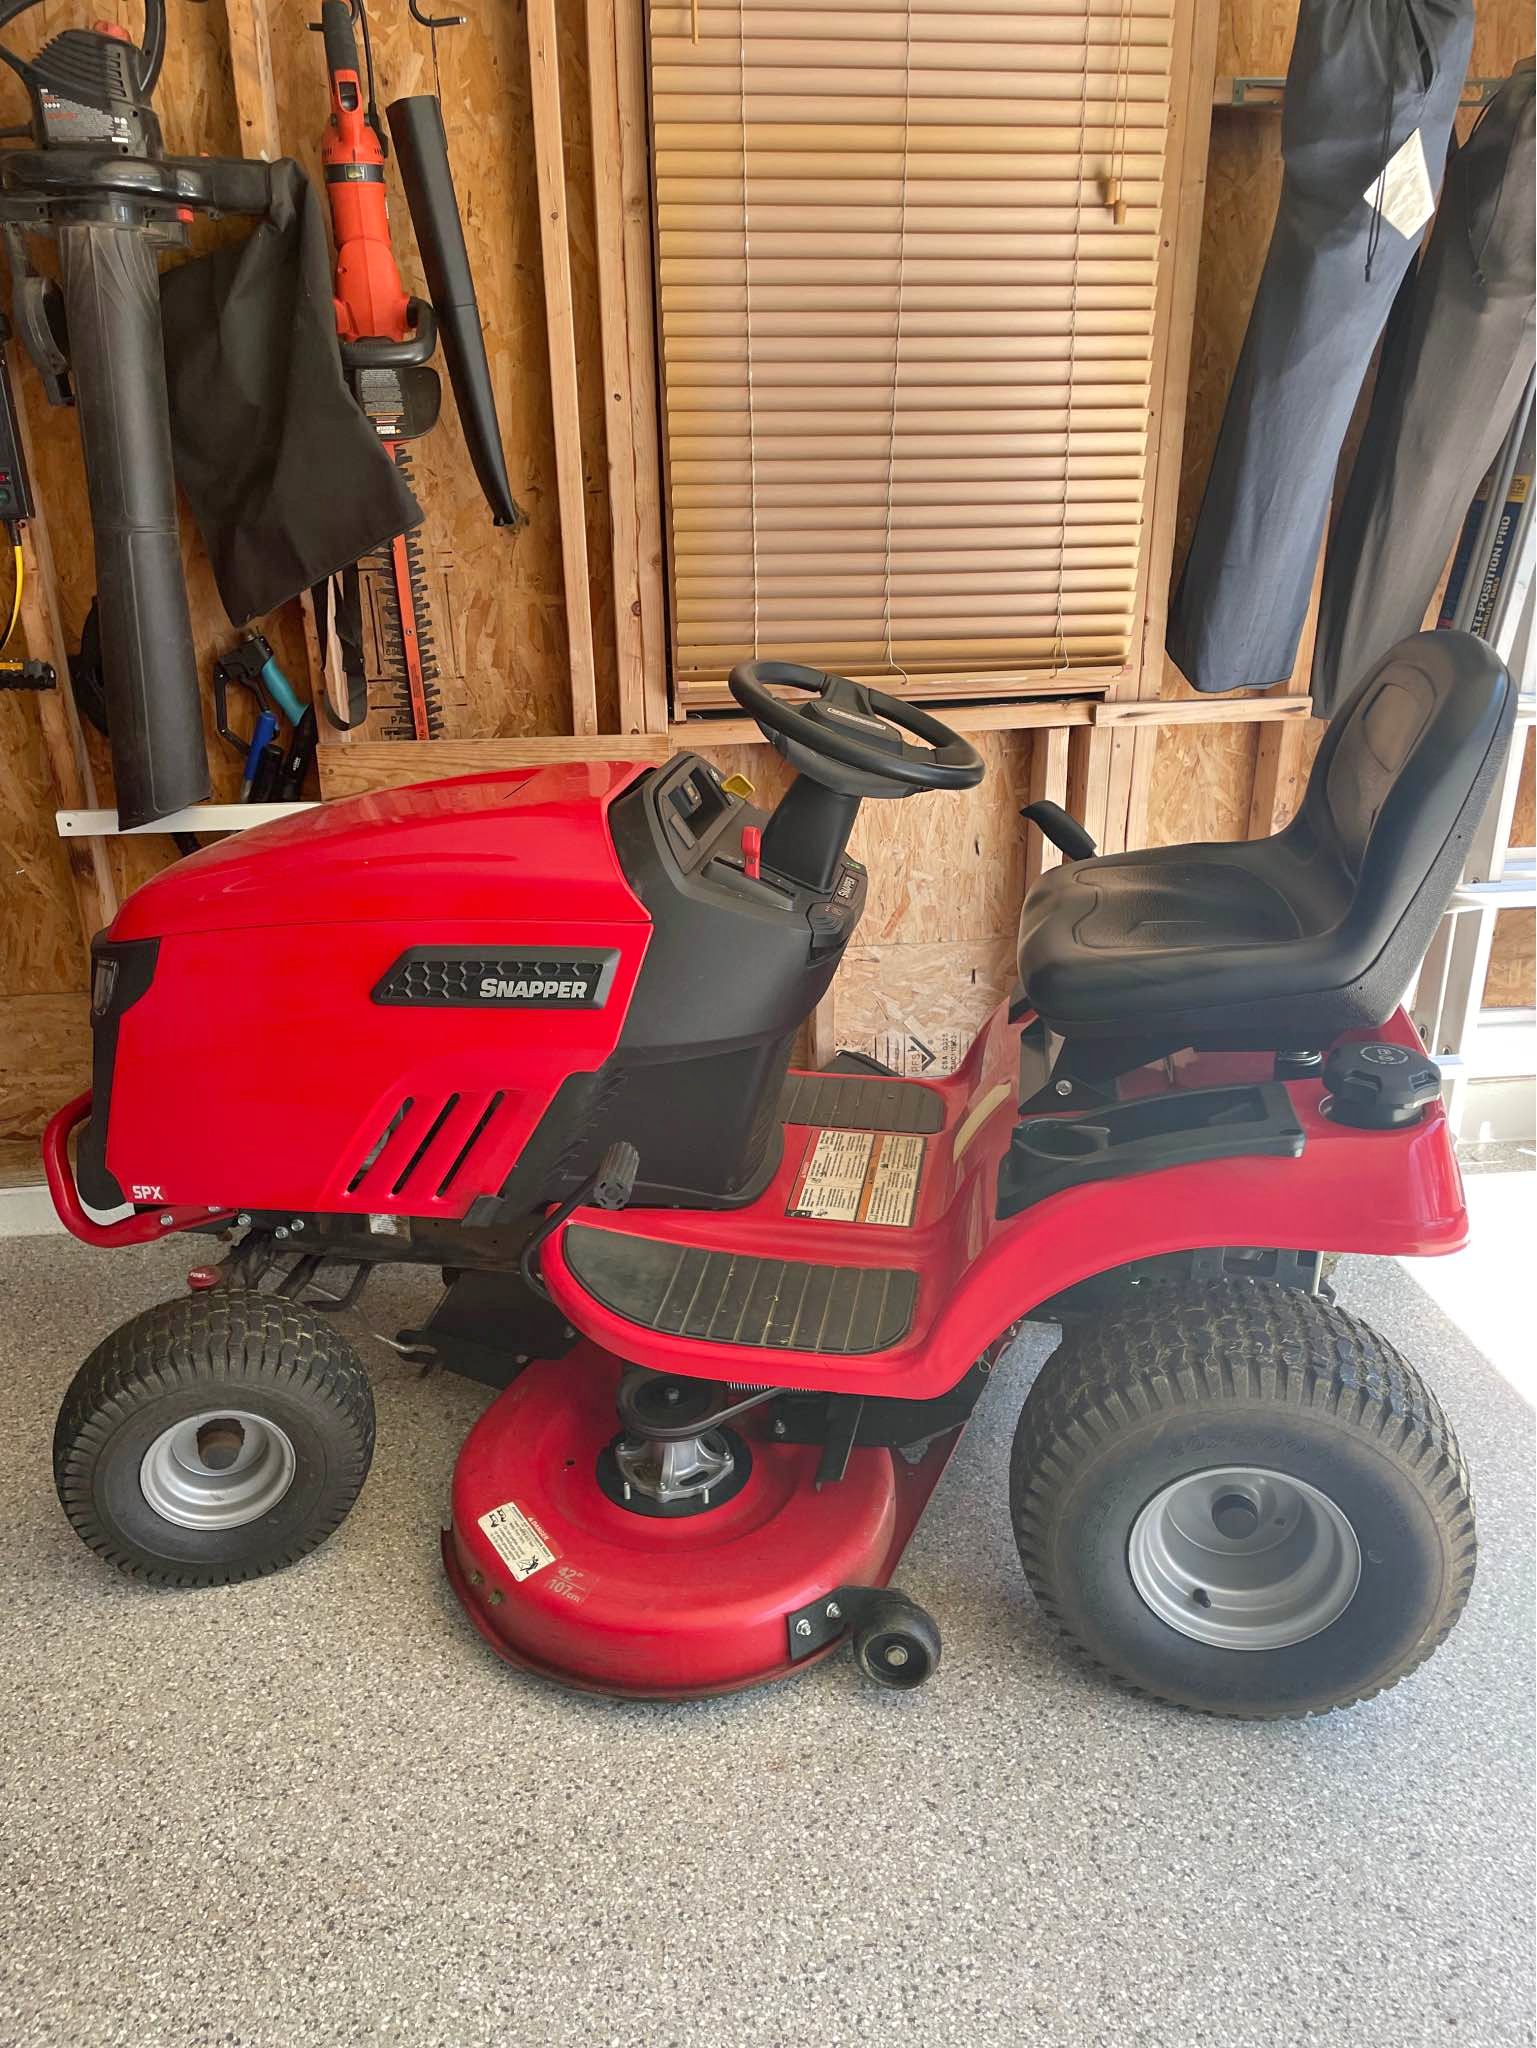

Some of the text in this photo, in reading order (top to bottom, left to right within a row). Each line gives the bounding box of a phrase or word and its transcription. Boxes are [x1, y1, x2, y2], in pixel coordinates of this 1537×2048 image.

[1496, 515, 1511, 545] PRO
[479, 978, 588, 999] SNAPPER
[132, 1185, 164, 1200] SPX
